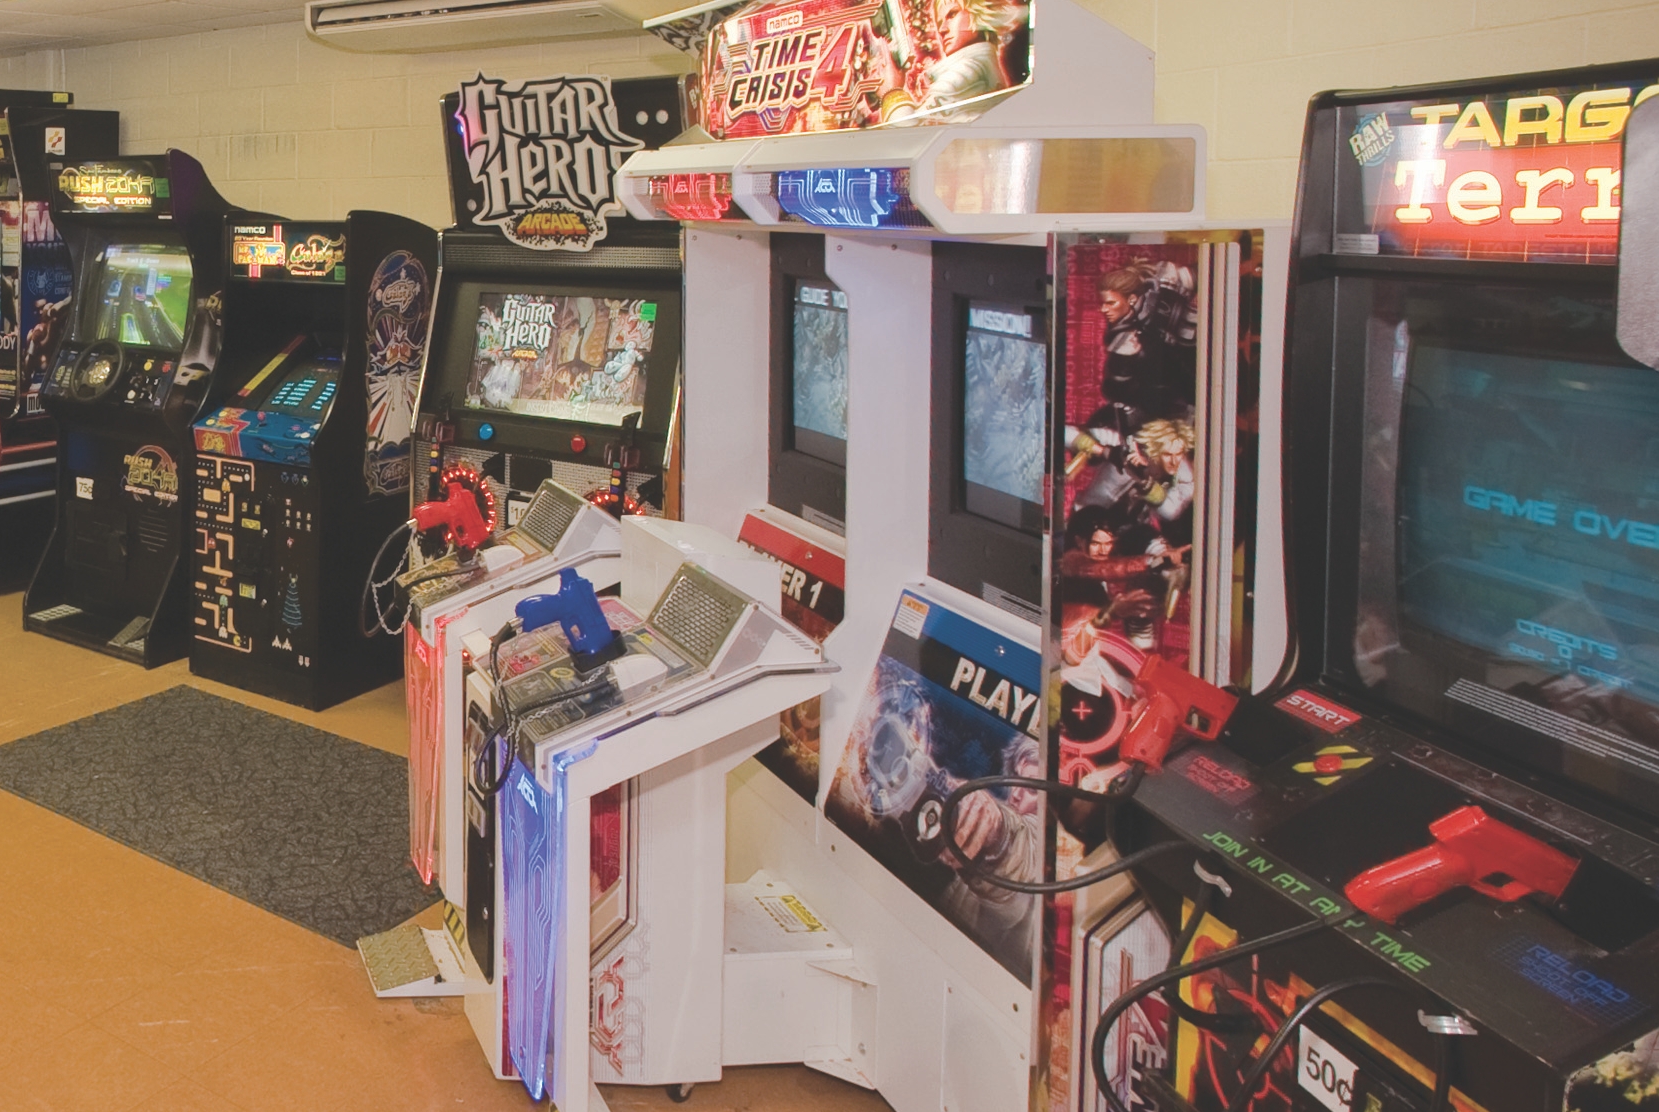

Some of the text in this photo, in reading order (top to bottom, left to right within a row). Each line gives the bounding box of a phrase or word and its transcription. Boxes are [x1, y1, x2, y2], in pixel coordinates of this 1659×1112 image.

[769, 15, 800, 30] namco
[728, 24, 856, 112] CRISIS 4
[753, 29, 824, 73] TIME
[463, 79, 624, 164] GUITAR
[1349, 111, 1391, 156] RAW
[1355, 130, 1396, 167] THRILLS
[58, 175, 105, 194] RUSH
[486, 133, 611, 217] HERO
[73, 196, 152, 206] SPECIAL EDITION
[234, 226, 266, 235] namco
[516, 211, 587, 236] ARCADE
[502, 299, 557, 330] GUITAR
[503, 319, 551, 351] HERO
[1463, 485, 1557, 526] GAME
[809, 580, 823, 610] 1
[1516, 618, 1618, 661] CREDITS
[1286, 694, 1351, 726] START
[1192, 755, 1252, 791] RELOAD
[1202, 831, 1249, 859] JOIN
[1247, 856, 1274, 874] IN
[1271, 872, 1311, 894] AT
[1370, 931, 1432, 973] TIME
[1526, 944, 1630, 1003] RELOAD
